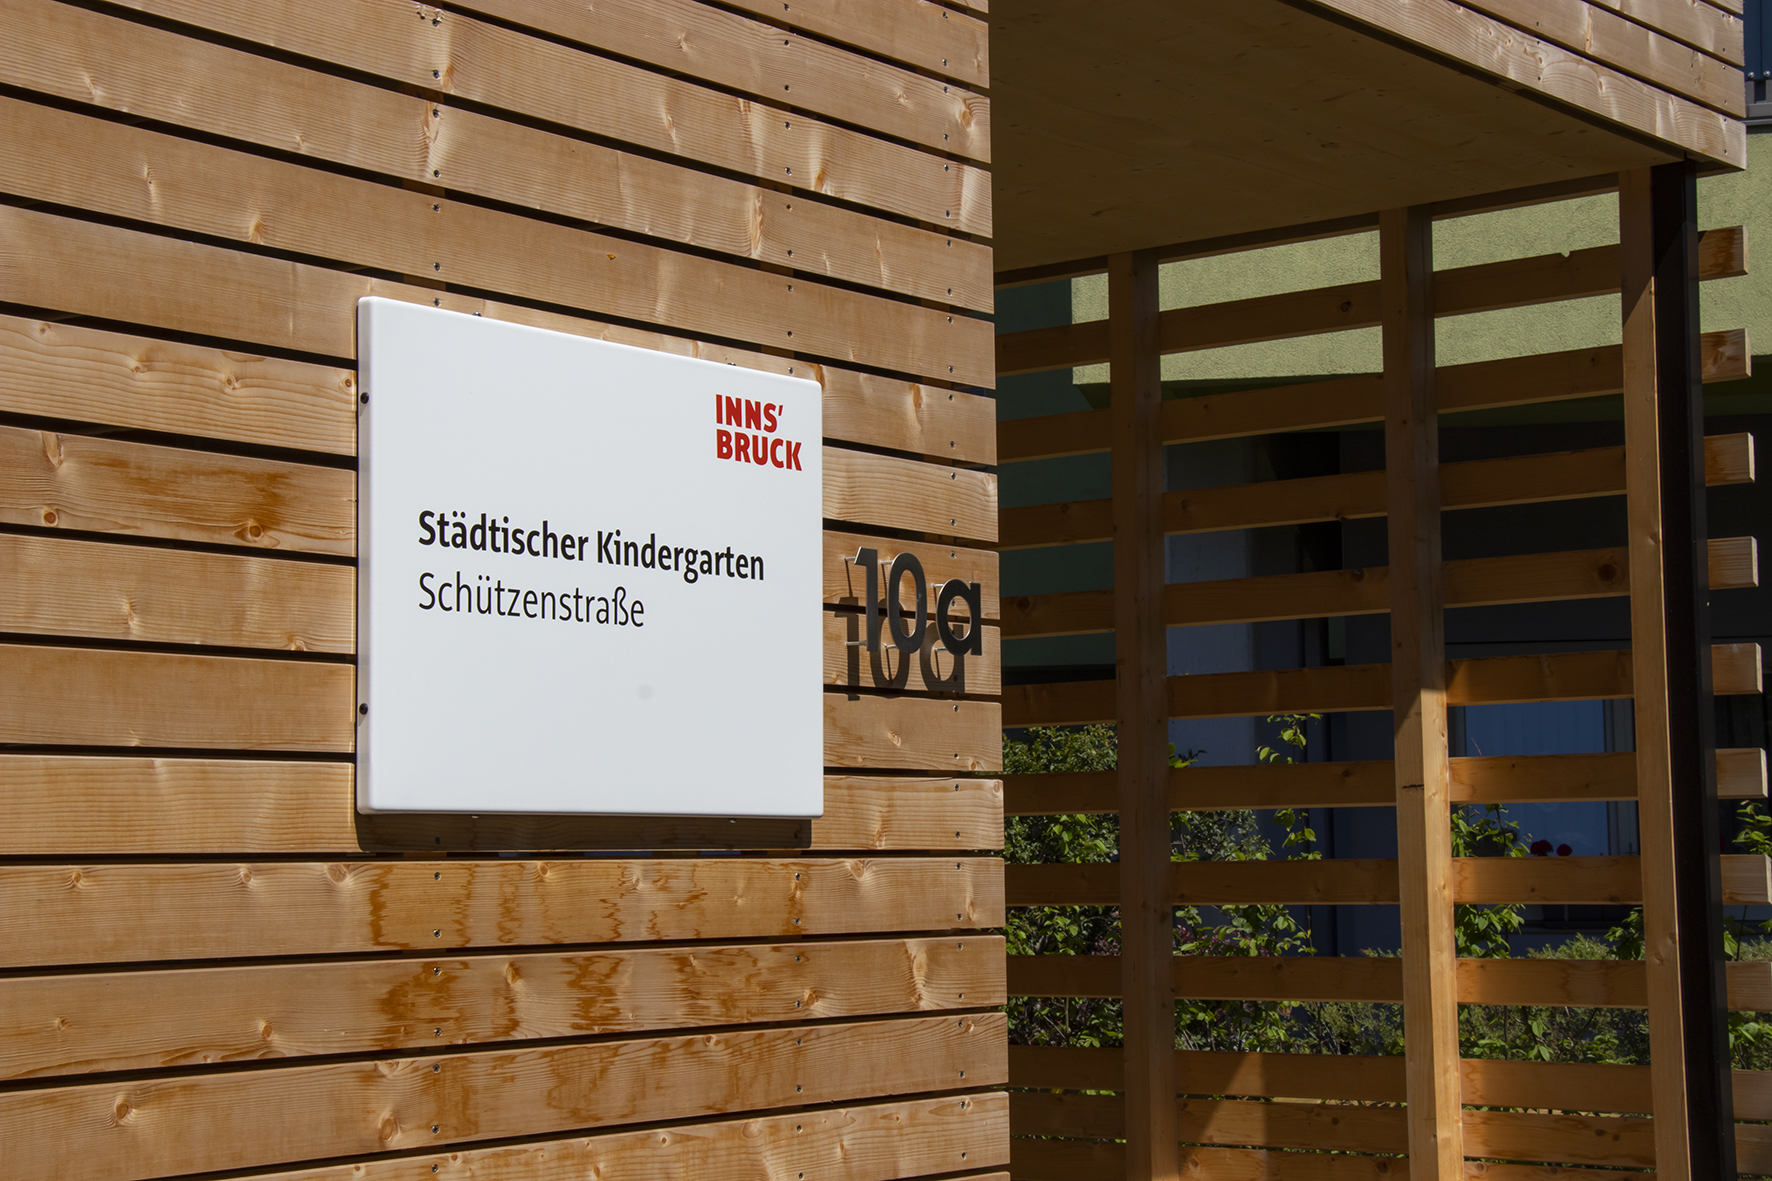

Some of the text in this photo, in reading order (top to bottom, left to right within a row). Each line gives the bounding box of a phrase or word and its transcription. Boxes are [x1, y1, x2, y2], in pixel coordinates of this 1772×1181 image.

[716, 429, 803, 472] BRUCK
[418, 510, 764, 584] Städtischer Kindergarten
[418, 571, 645, 628] Schützenstraße
[854, 546, 982, 656] 10a
